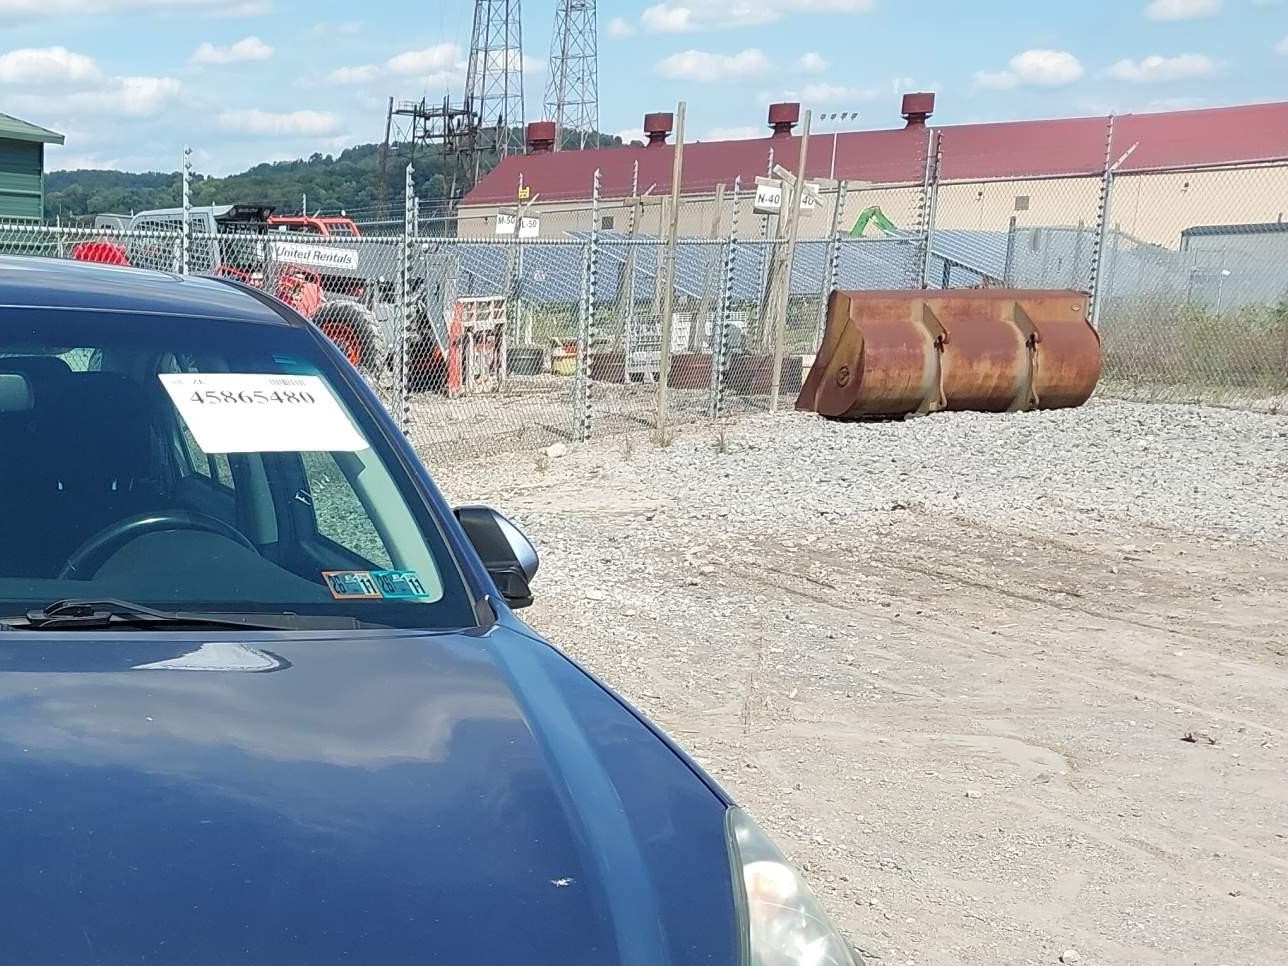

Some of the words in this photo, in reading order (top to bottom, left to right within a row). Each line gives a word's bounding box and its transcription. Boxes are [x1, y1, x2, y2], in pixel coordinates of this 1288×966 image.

[277, 245, 311, 260] United
[312, 250, 352, 264] Rentals
[190, 390, 316, 405] 45865480
[360, 578, 378, 594] 11
[408, 578, 426, 594] 11
